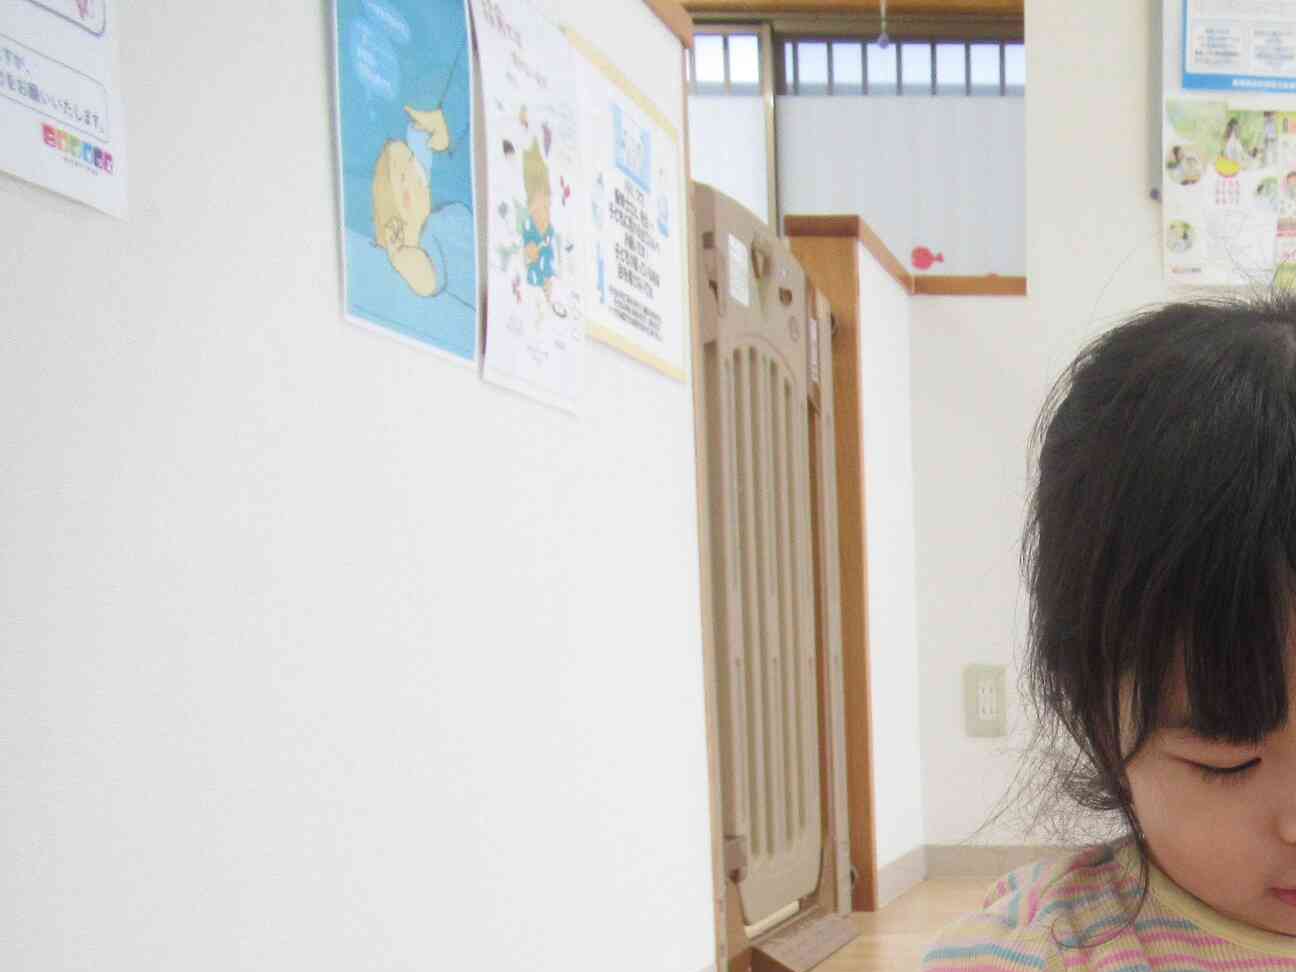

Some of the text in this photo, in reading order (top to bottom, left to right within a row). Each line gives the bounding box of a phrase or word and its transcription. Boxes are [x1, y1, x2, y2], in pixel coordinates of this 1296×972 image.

[0, 71, 105, 134] をお願いいたします。
